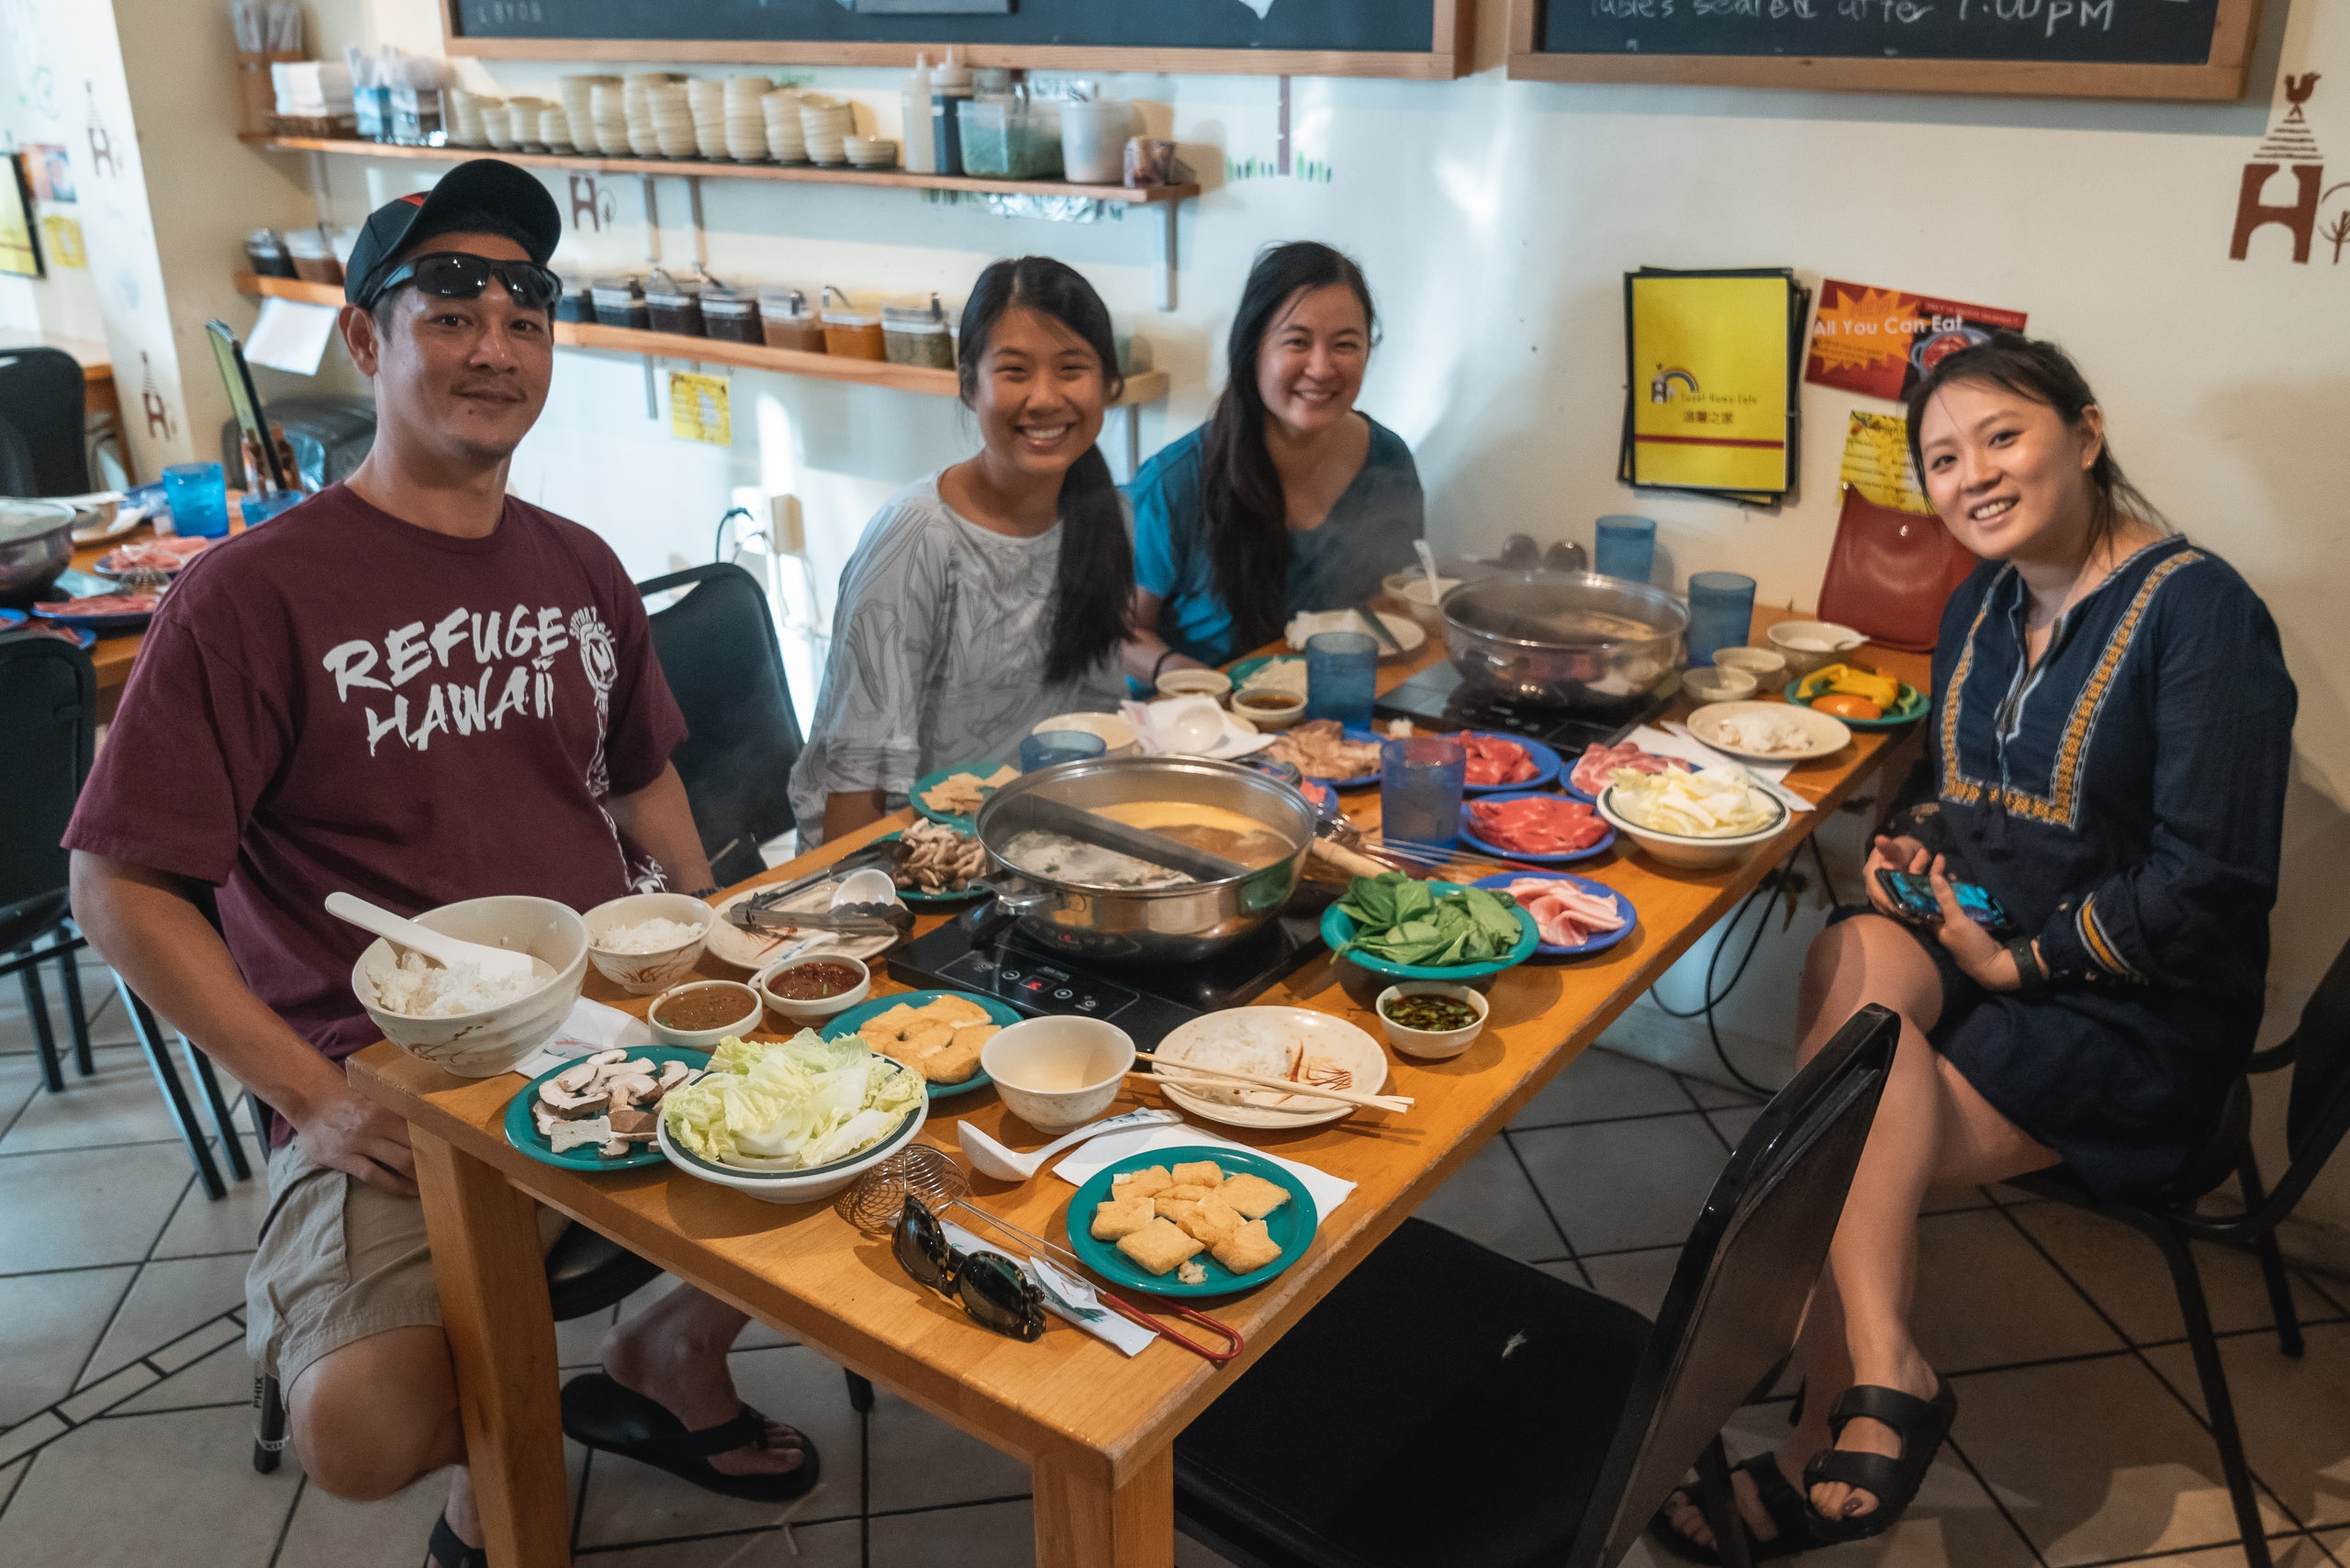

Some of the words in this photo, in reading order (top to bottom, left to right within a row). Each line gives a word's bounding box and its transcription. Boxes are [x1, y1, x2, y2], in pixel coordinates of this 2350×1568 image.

[1813, 319, 1836, 336] All
[1841, 319, 1878, 336] You
[1884, 316, 1927, 334] Can
[1930, 314, 1964, 333] Eat
[322, 603, 569, 703] REFUGE
